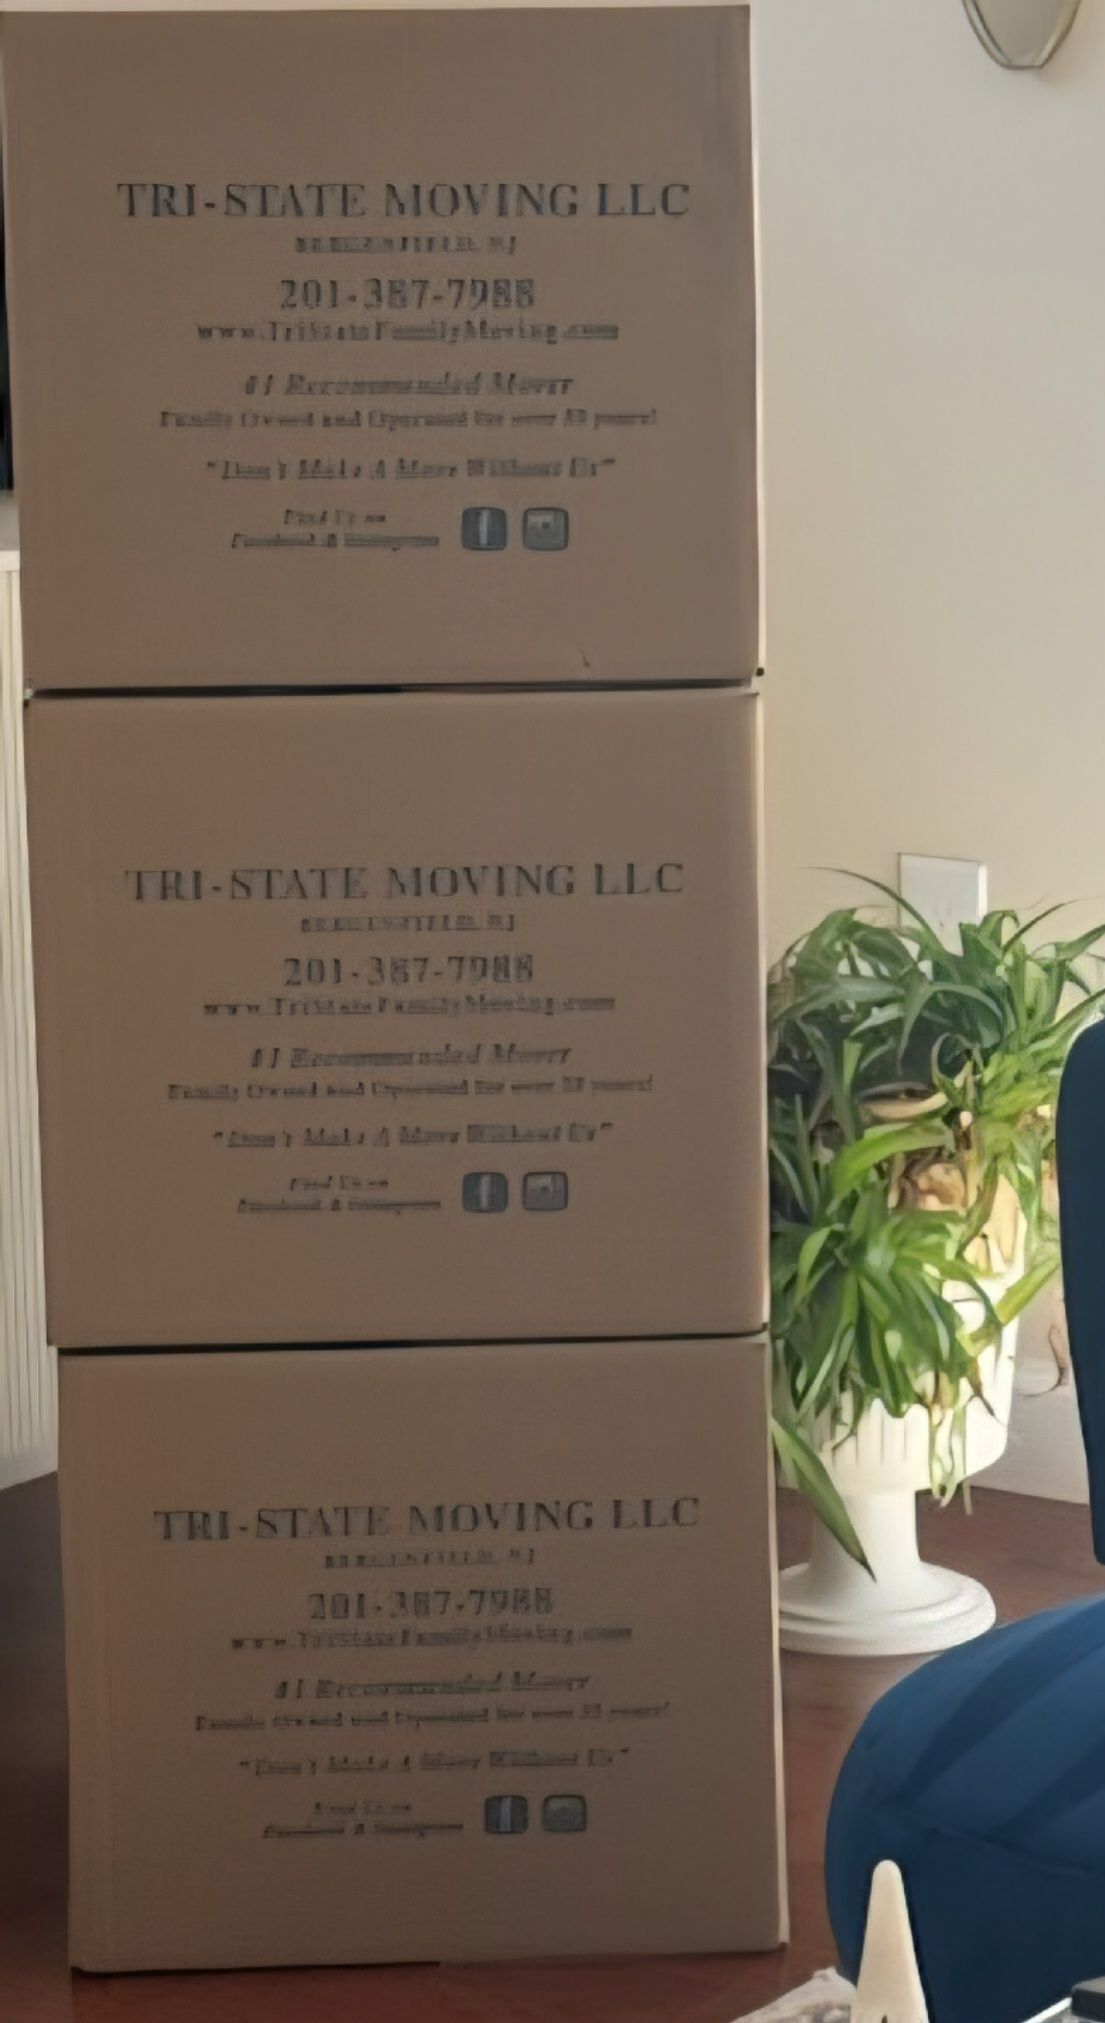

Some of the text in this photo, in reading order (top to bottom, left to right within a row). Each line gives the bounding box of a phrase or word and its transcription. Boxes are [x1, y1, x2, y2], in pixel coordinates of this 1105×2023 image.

[117, 183, 691, 217] TRI-STATE MOVING LLC
[280, 277, 534, 309] 201-387-7988
[125, 862, 685, 901] TRI-STATE MOVING LLC
[153, 1497, 699, 1541] TRI-STATE MOVING LLC
